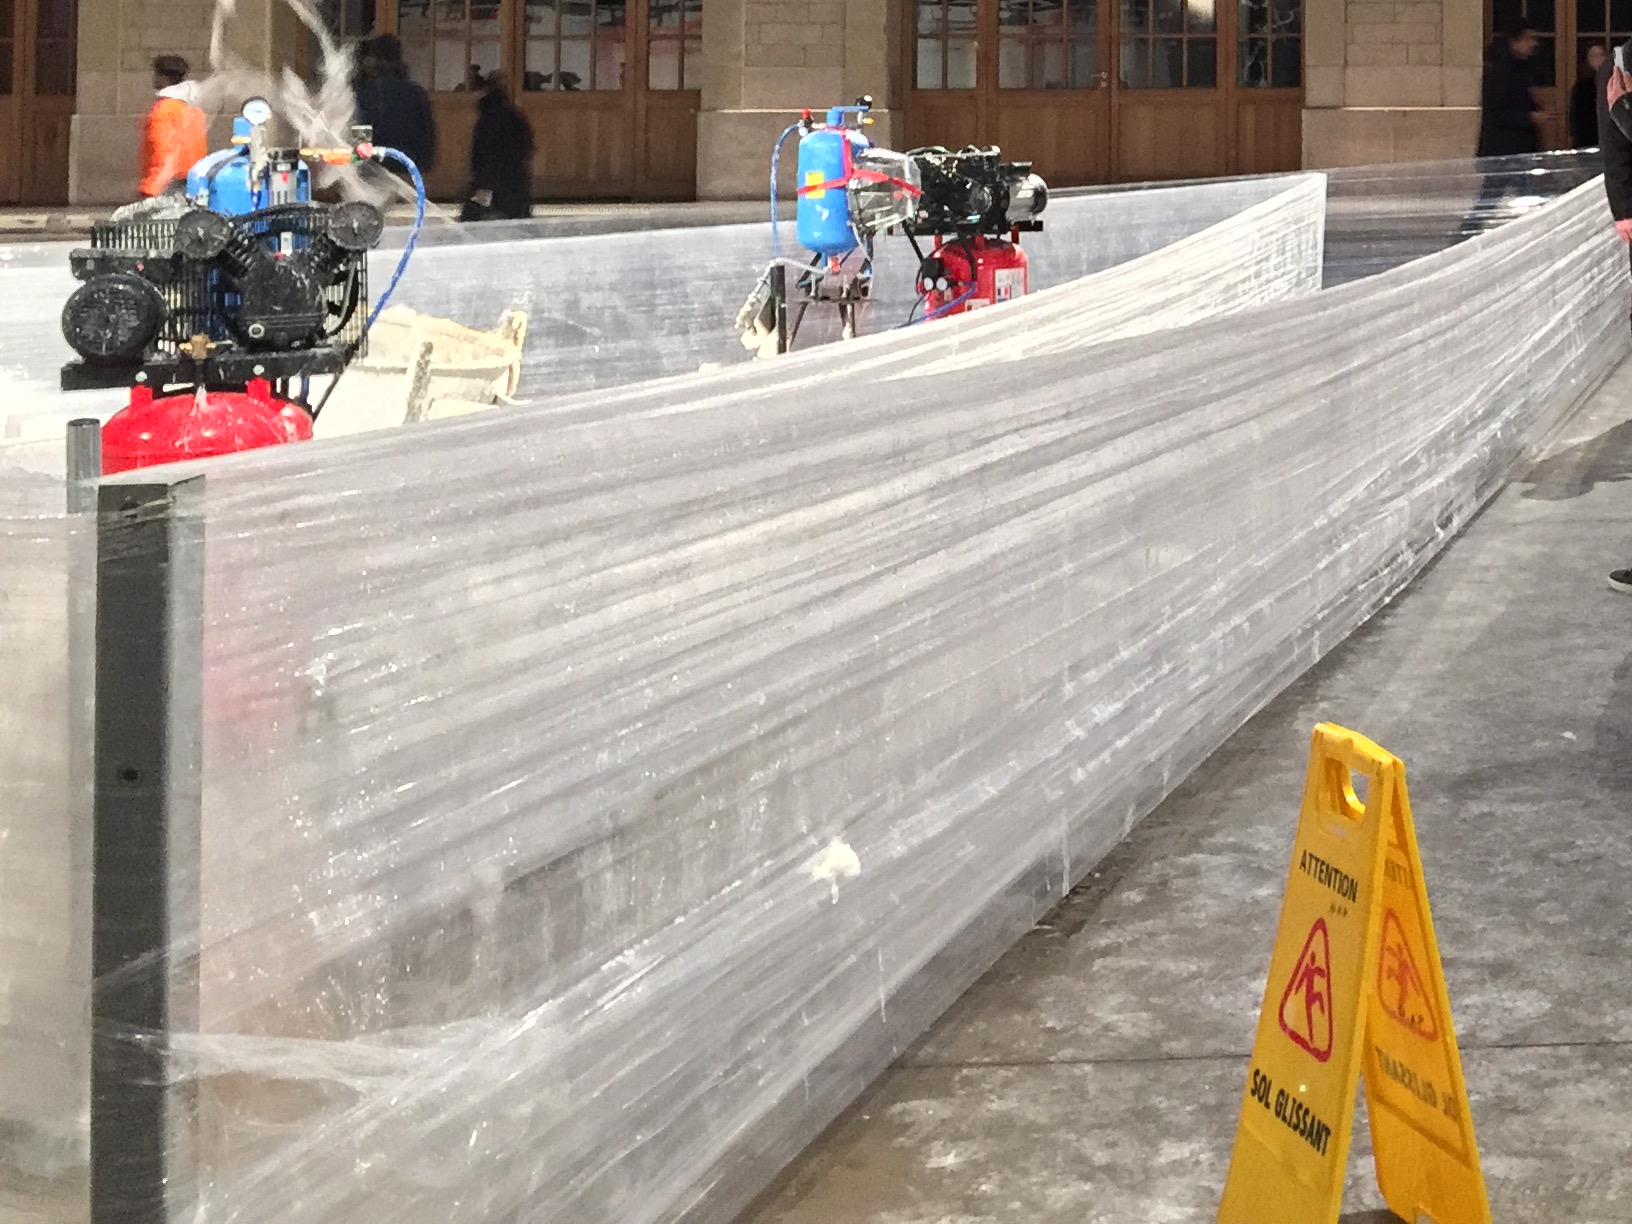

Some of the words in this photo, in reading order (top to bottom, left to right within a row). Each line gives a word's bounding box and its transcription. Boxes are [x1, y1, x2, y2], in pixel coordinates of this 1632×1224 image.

[1300, 849, 1358, 903] ATTENTION
[1250, 1068, 1272, 1110] SOL
[1275, 1087, 1331, 1156] GLISSANT
